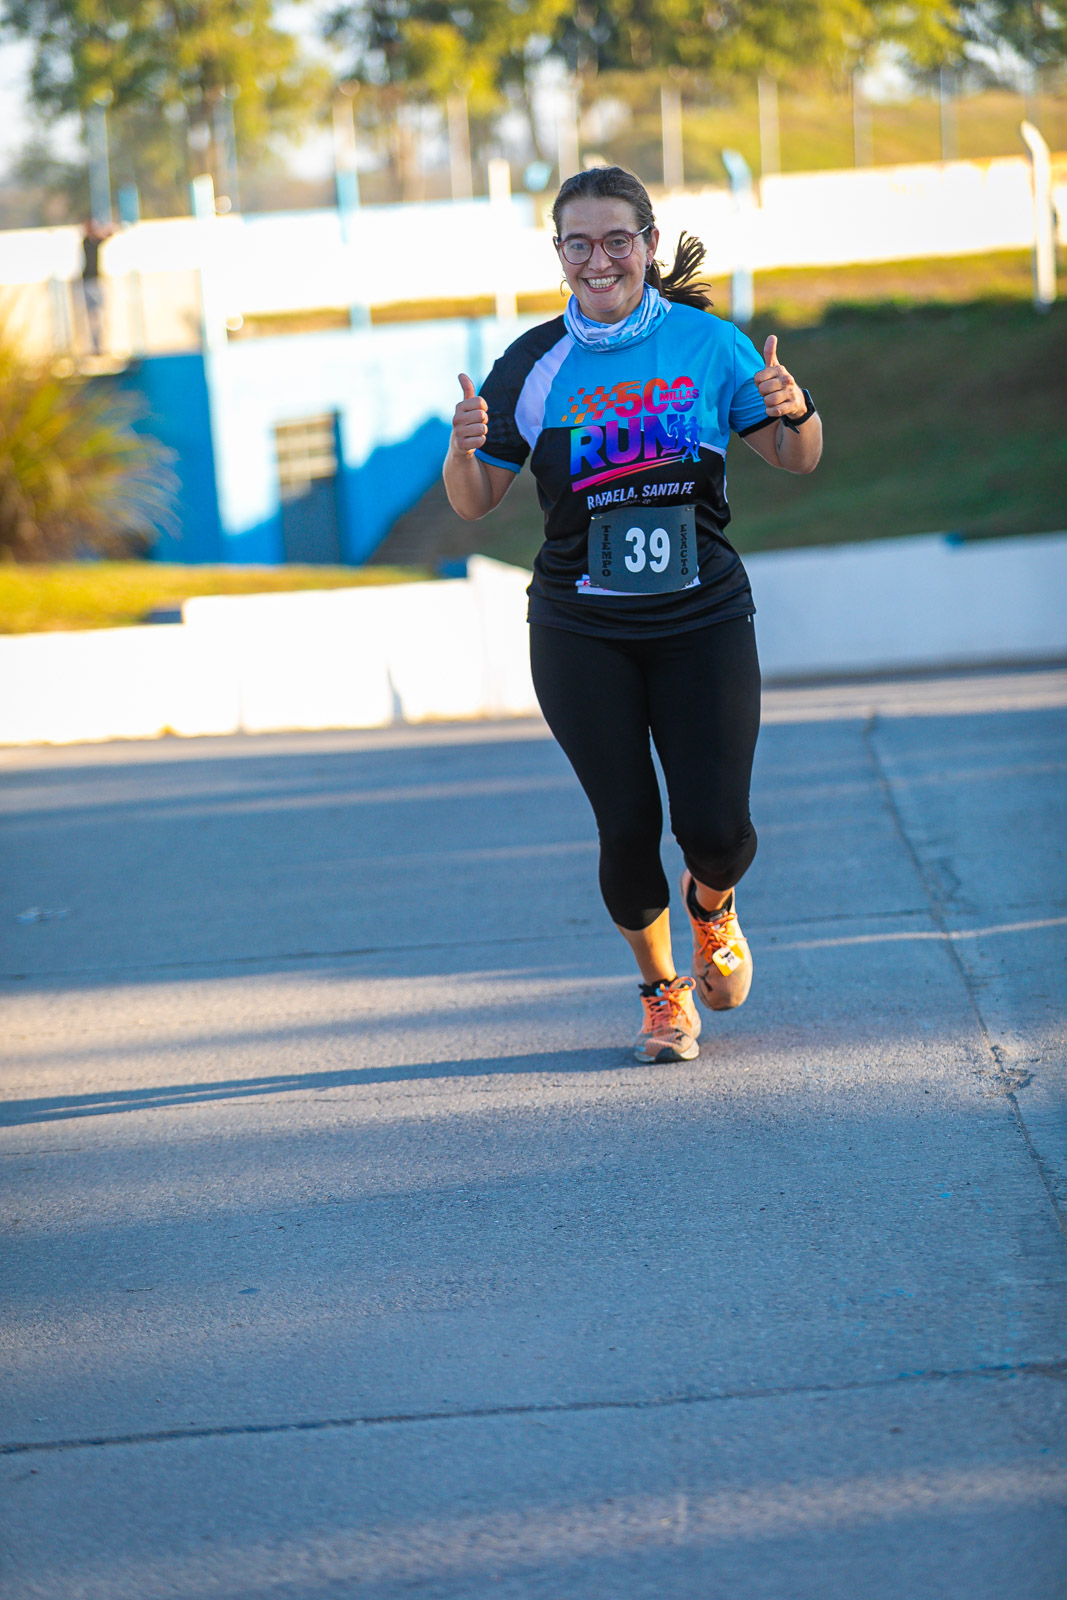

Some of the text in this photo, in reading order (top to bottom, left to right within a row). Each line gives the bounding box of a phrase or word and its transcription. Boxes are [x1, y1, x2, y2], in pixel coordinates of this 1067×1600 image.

[612, 376, 695, 418] 500
[659, 388, 700, 402] MILLAS
[570, 413, 679, 476] RUN
[587, 486, 638, 510] RAFAELA,
[642, 482, 682, 497] SANTA
[680, 481, 696, 495] FE
[601, 524, 612, 577] TIEMPO
[624, 527, 671, 573] 39
[680, 523, 690, 576] EXACTO
